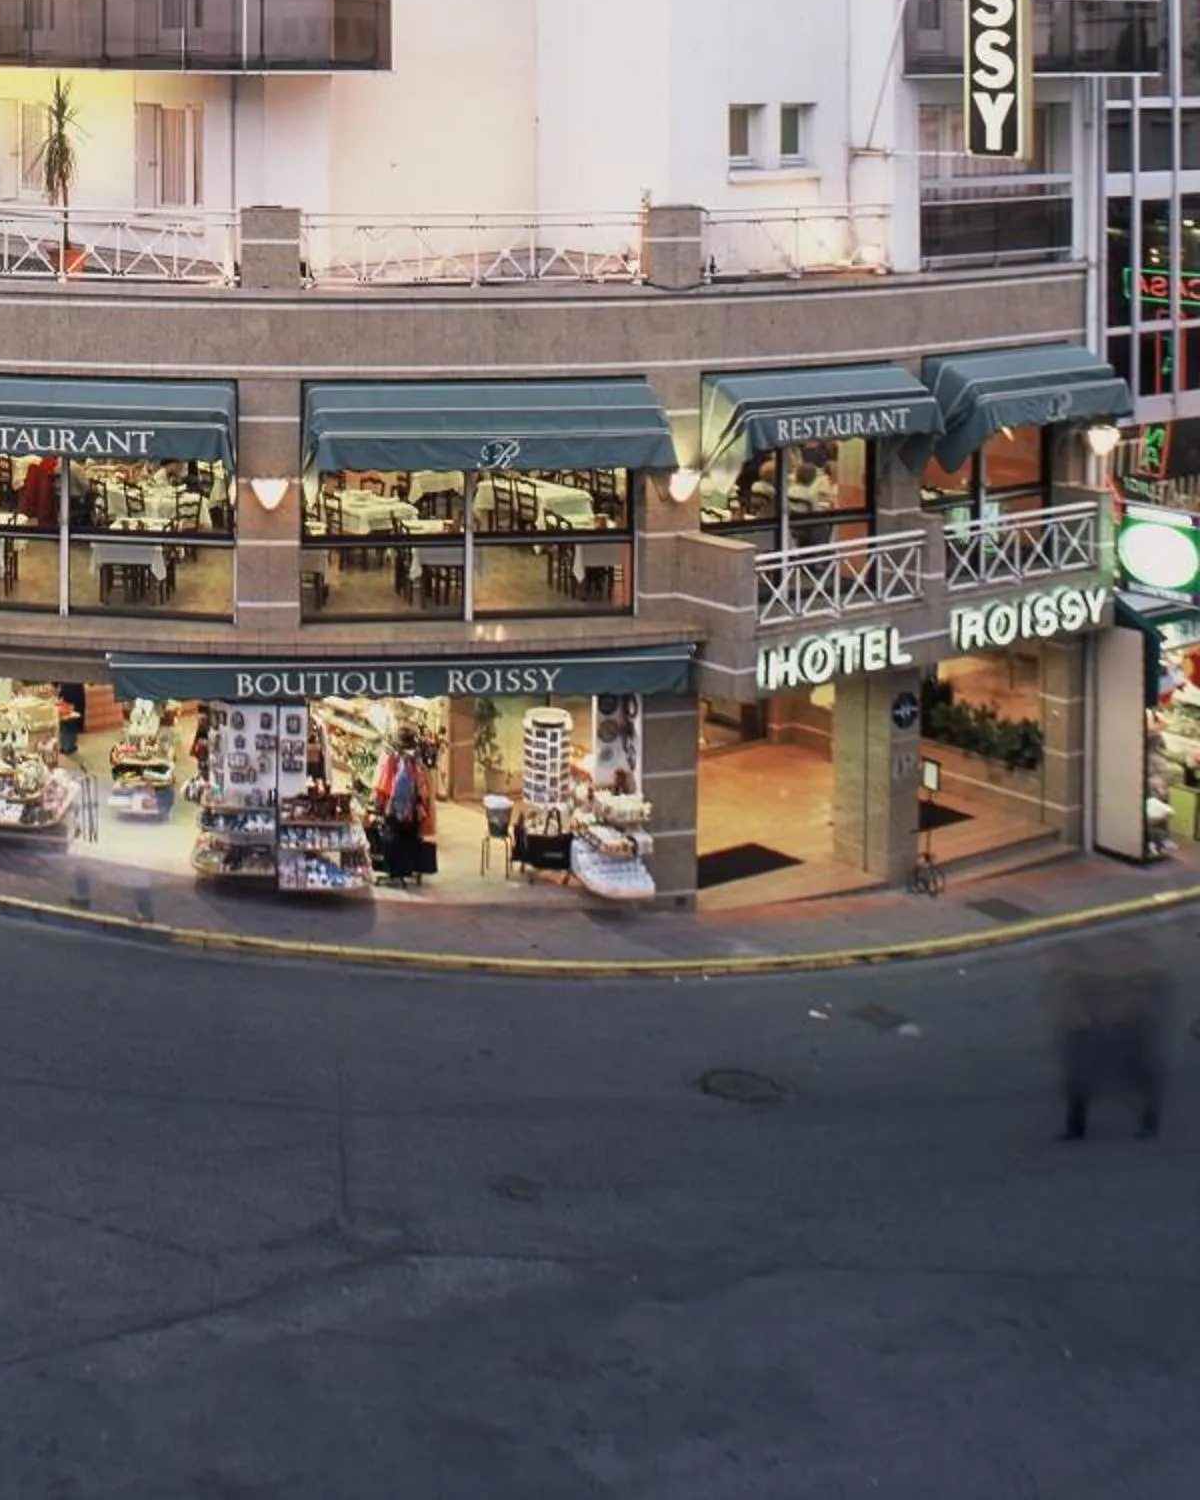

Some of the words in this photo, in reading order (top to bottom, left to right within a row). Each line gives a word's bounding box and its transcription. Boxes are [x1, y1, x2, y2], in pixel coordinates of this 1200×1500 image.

[777, 407, 911, 441] RESTAURANT
[756, 624, 913, 690] HOTEL
[950, 584, 1107, 650] ROISSY
[235, 671, 415, 698] BOUTIQUE
[448, 666, 563, 694] ROISSY
